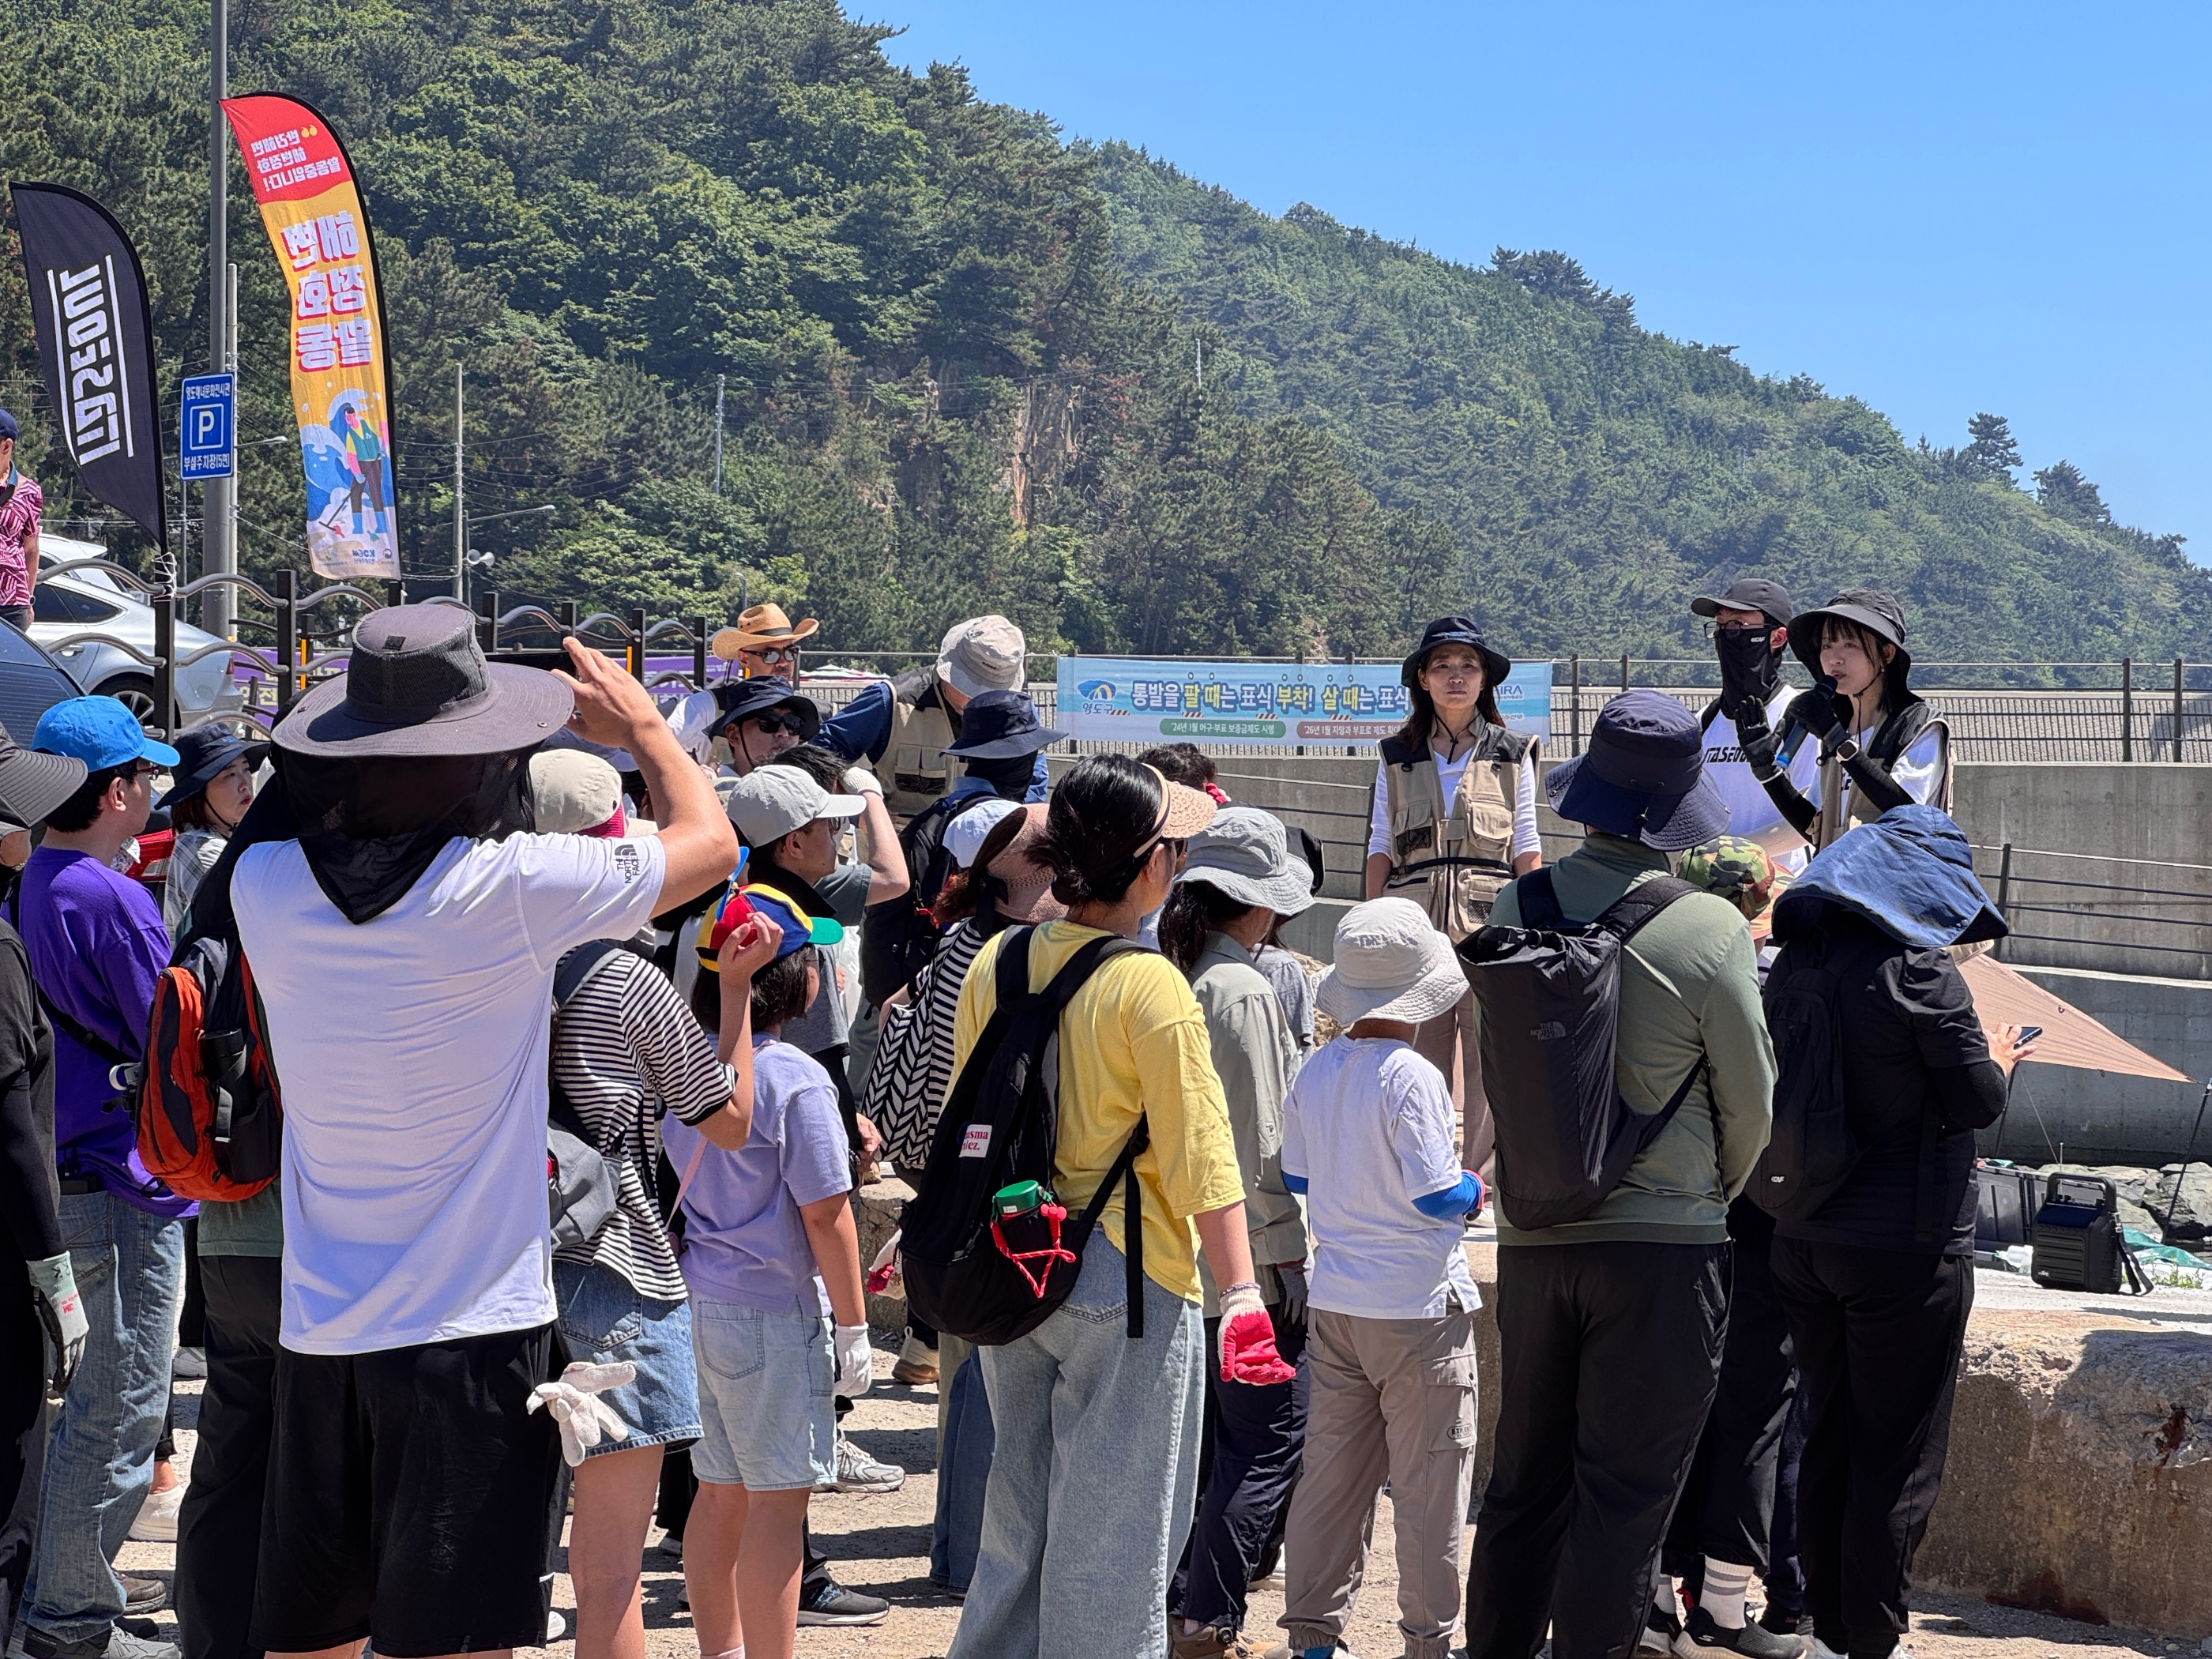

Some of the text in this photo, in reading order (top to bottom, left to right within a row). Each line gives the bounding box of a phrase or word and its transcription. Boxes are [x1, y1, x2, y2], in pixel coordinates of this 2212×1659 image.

[186, 382, 231, 401] 영도해녀문화전시관
[198, 410, 215, 444] P
[1131, 680, 1409, 711] 통발을 팔 때는 표식 부착! 살 때는 표식
[1495, 685, 1523, 695] IRA
[1082, 702, 1113, 715] 영도구
[1228, 724, 1261, 734] 보증금제도
[1261, 724, 1275, 735] 시행
[1332, 724, 1352, 735] 자망과
[1352, 724, 1372, 735] 부표로
[1373, 724, 1386, 735] 제도
[1702, 747, 1751, 764] ITASEOU
[623, 856, 632, 884] NORTH
[631, 856, 641, 876] FACE
[1530, 1027, 1553, 1036] NORTH
[1540, 1021, 1554, 1030] THE
